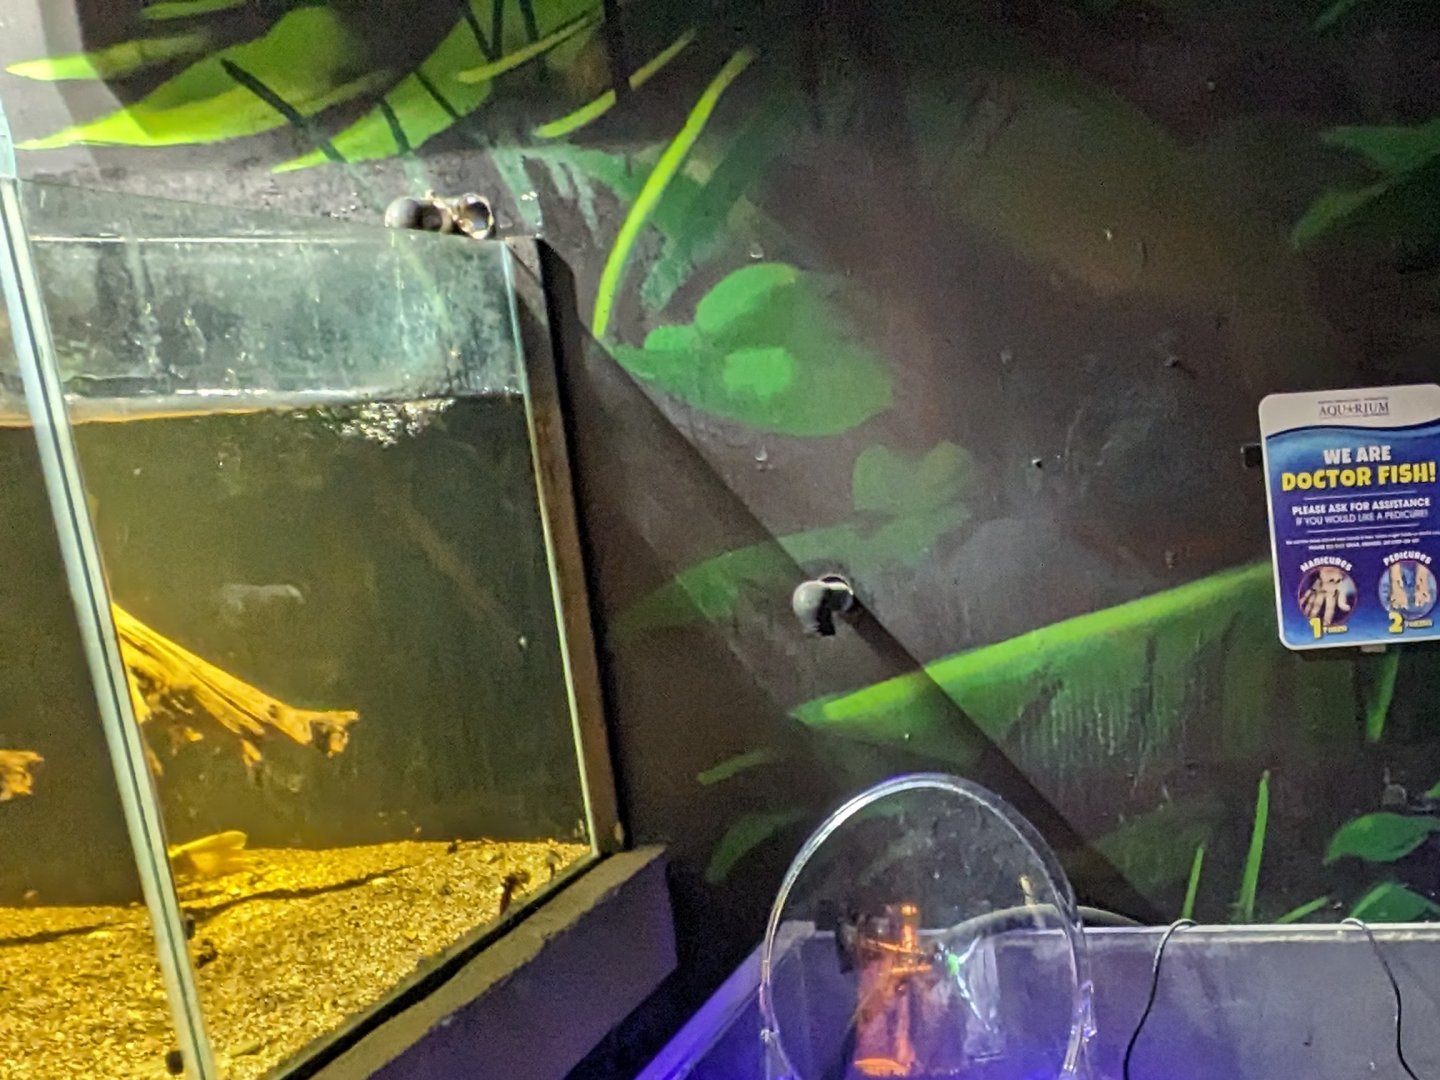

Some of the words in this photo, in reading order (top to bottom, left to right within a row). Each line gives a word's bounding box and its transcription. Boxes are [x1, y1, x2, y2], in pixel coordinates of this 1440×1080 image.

[1324, 449, 1351, 464] WE
[1356, 445, 1391, 462] ARE
[1282, 467, 1371, 491] DOCTOR
[1377, 462, 1436, 485] FISH!
[1292, 503, 1326, 515] PLEASE
[1328, 502, 1348, 513] ASK
[1350, 501, 1370, 511] FOR
[1372, 497, 1430, 510] ASSISTANCE
[1296, 518, 1303, 526] IF
[1304, 516, 1322, 525] YOU
[1325, 514, 1356, 524] WOULD
[1358, 512, 1374, 522] LIKE
[1377, 512, 1383, 520] A
[1300, 556, 1353, 572] MANICURES
[1382, 550, 1432, 566] PEDICURES
[1309, 617, 1322, 639] 1
[1388, 611, 1403, 634] 2
